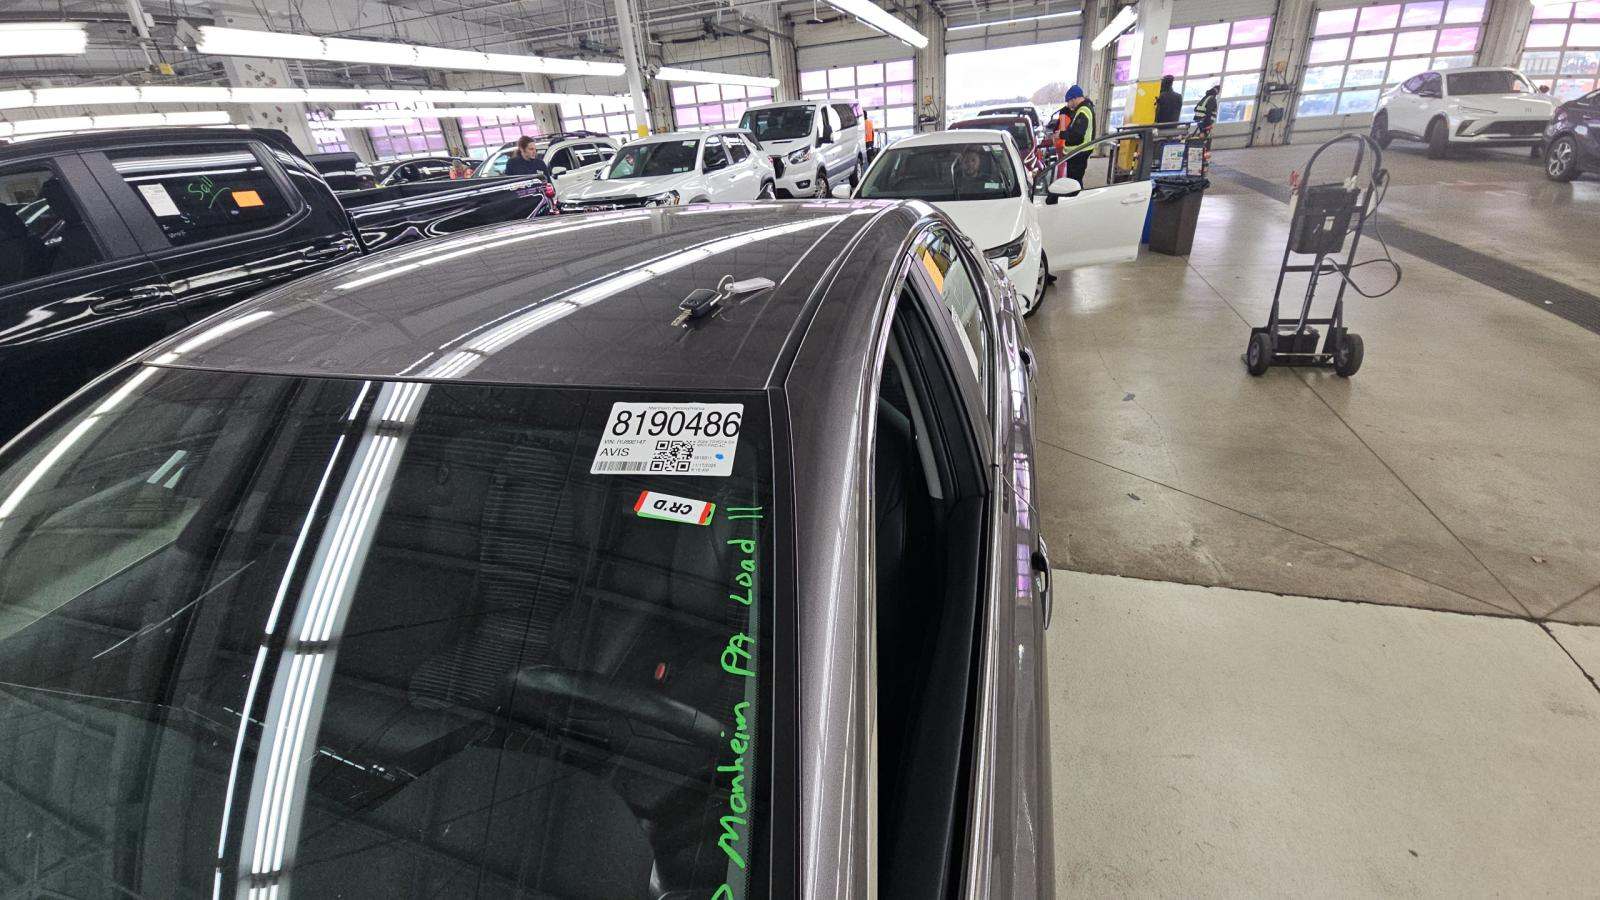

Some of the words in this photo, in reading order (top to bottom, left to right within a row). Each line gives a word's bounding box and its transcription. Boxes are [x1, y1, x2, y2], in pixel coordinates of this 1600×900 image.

[612, 410, 743, 438] 8190486
[600, 447, 630, 457] AVIS
[653, 499, 693, 515] CR'D
[726, 539, 756, 605] Load
[720, 632, 756, 677] PA
